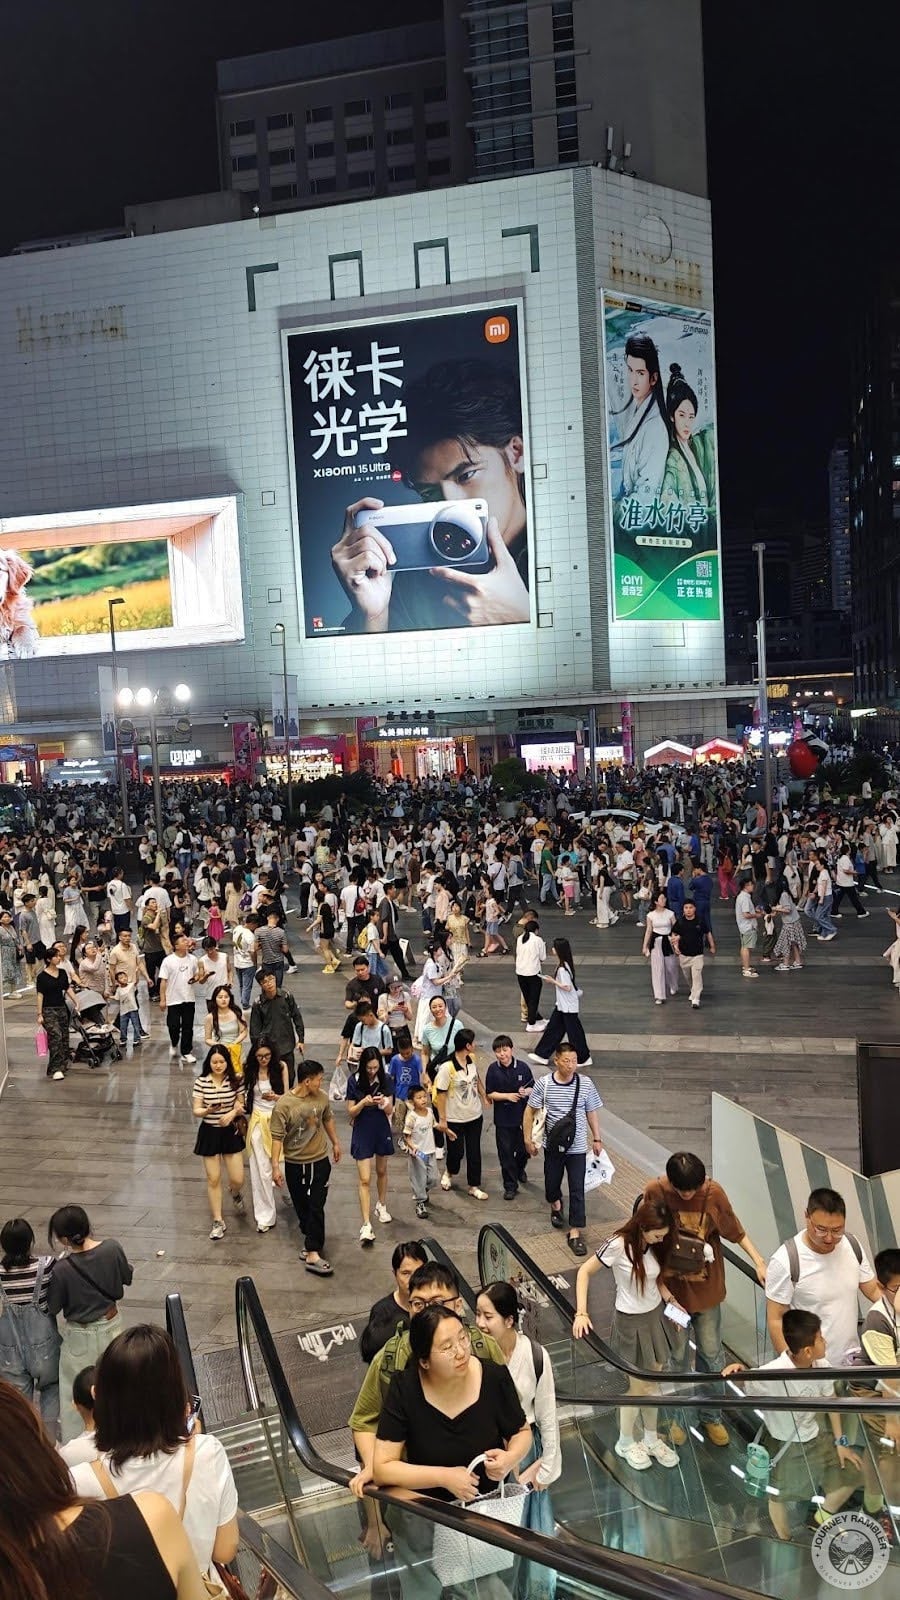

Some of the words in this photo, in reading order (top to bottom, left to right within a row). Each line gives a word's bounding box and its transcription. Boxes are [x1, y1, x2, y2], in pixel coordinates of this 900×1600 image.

[302, 341, 404, 403] 徕卡
[310, 399, 408, 460] 光学
[358, 463, 368, 474] 15
[369, 462, 391, 473] Ultra
[619, 496, 708, 534] 淮水竹亭
[621, 575, 643, 585] iQIYI
[676, 586, 713, 598] 正在热播
